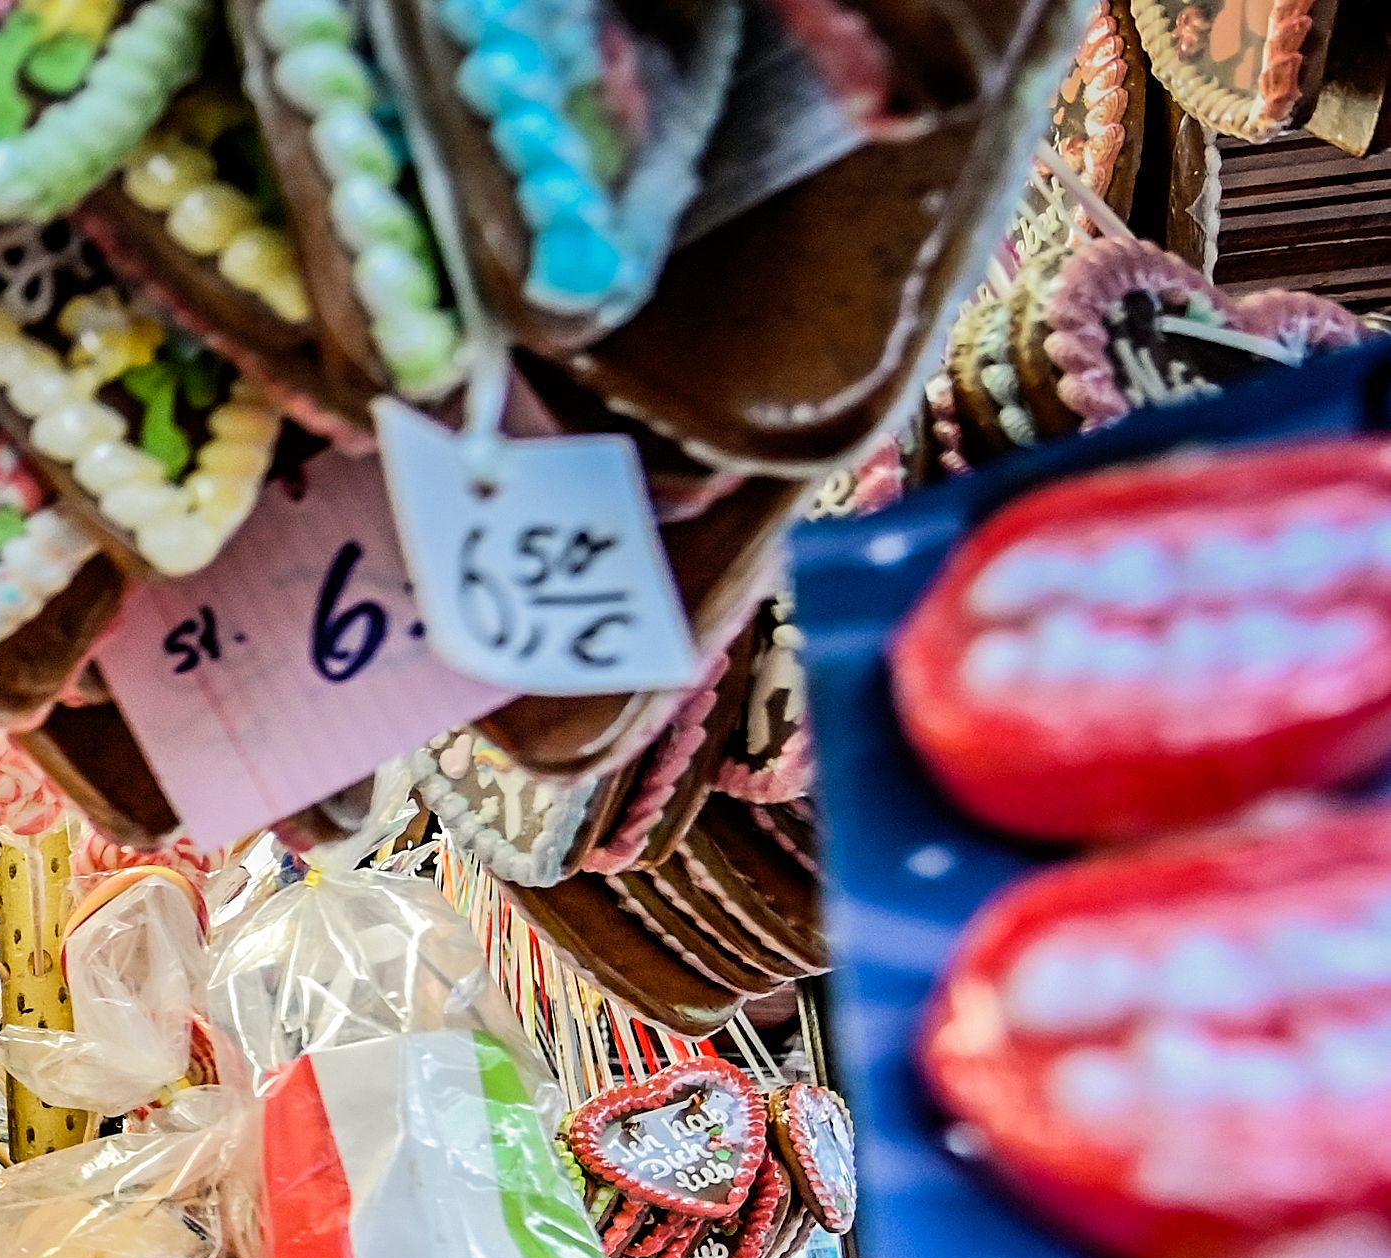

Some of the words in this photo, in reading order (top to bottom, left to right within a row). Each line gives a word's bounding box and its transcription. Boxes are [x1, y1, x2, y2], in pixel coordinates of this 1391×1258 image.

[607, 1130, 666, 1165] Ich
[660, 1106, 730, 1142] hab
[637, 1141, 714, 1181] Dich
[674, 1159, 735, 1193] lieb
